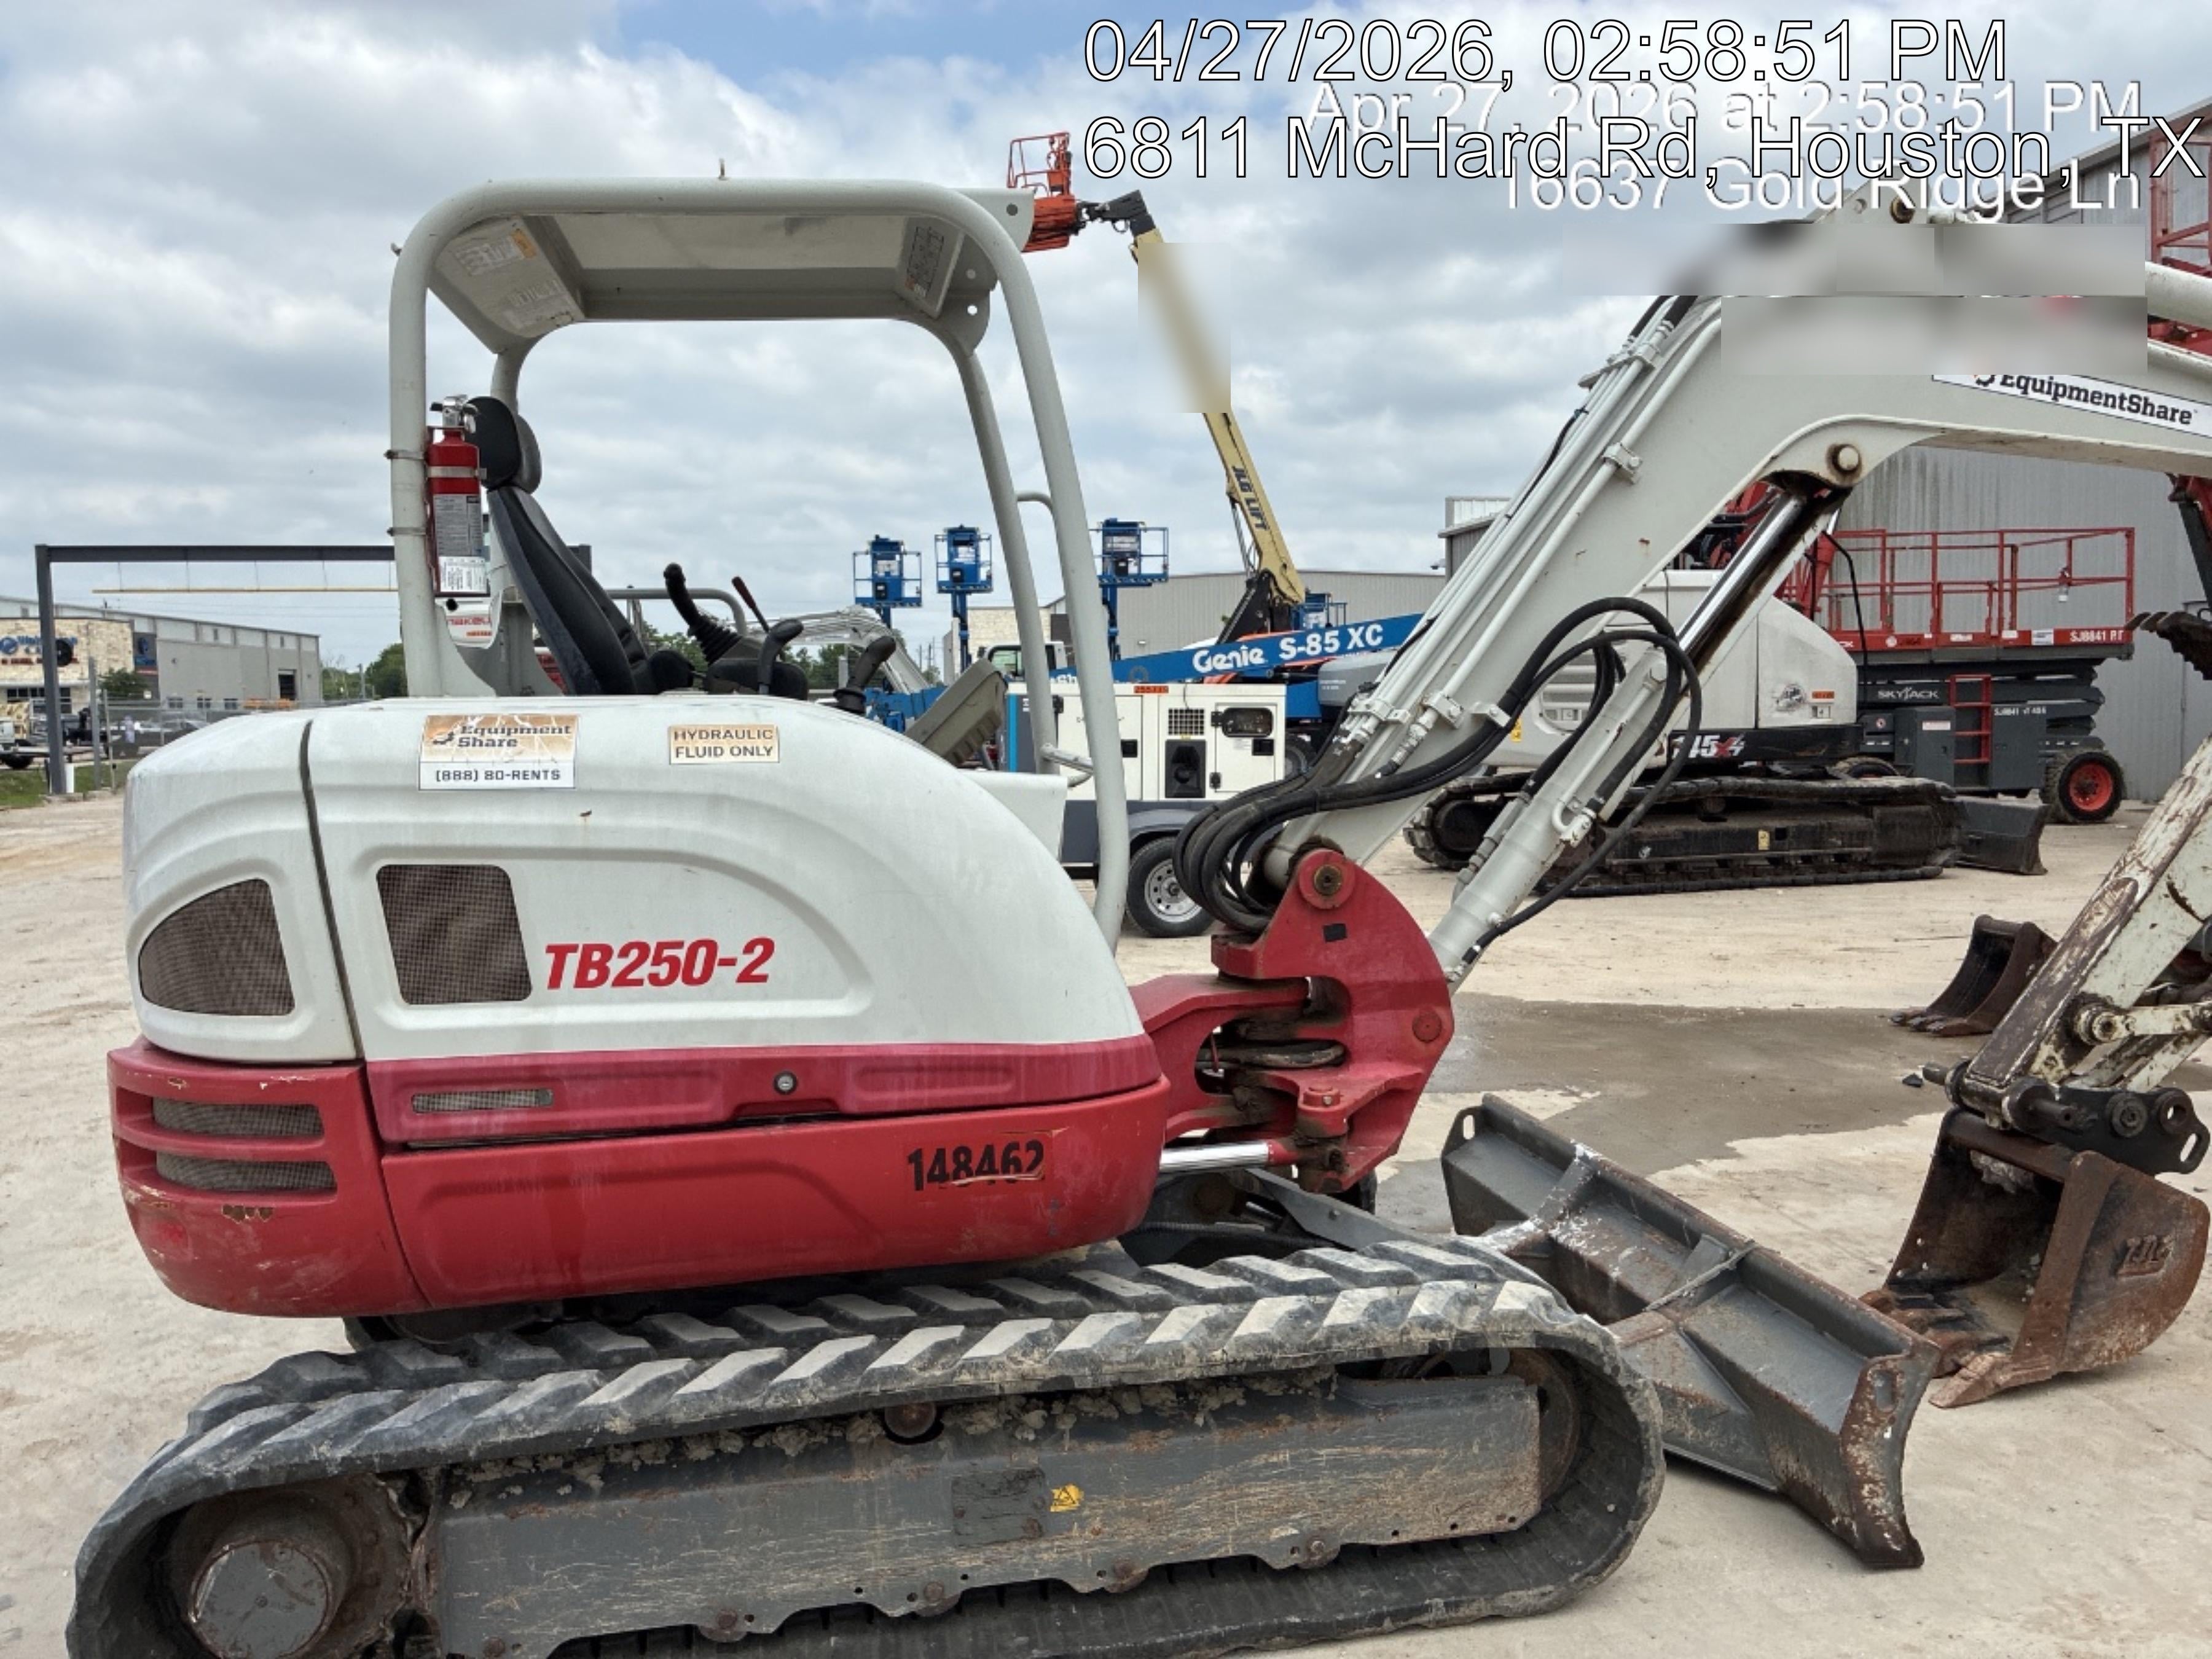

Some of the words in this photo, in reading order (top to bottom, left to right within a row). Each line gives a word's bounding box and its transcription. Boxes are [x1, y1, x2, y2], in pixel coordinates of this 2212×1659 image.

[1999, 374, 2193, 425] EquipmentShare
[1231, 466, 1253, 492] JLG
[1244, 496, 1271, 531] LIFT
[1193, 645, 1266, 673] Genie
[1279, 630, 1341, 661] S-85
[1346, 624, 1383, 649] XC
[1877, 686, 1939, 701] SKYJACK
[458, 737, 518, 748] Share
[460, 725, 573, 736] Equipment
[674, 729, 774, 740] HYDRAULIC
[676, 746, 725, 758] FLUID
[729, 745, 774, 757] ONLY
[544, 937, 775, 990] TB250-2
[908, 1139, 1045, 1191] 148462
